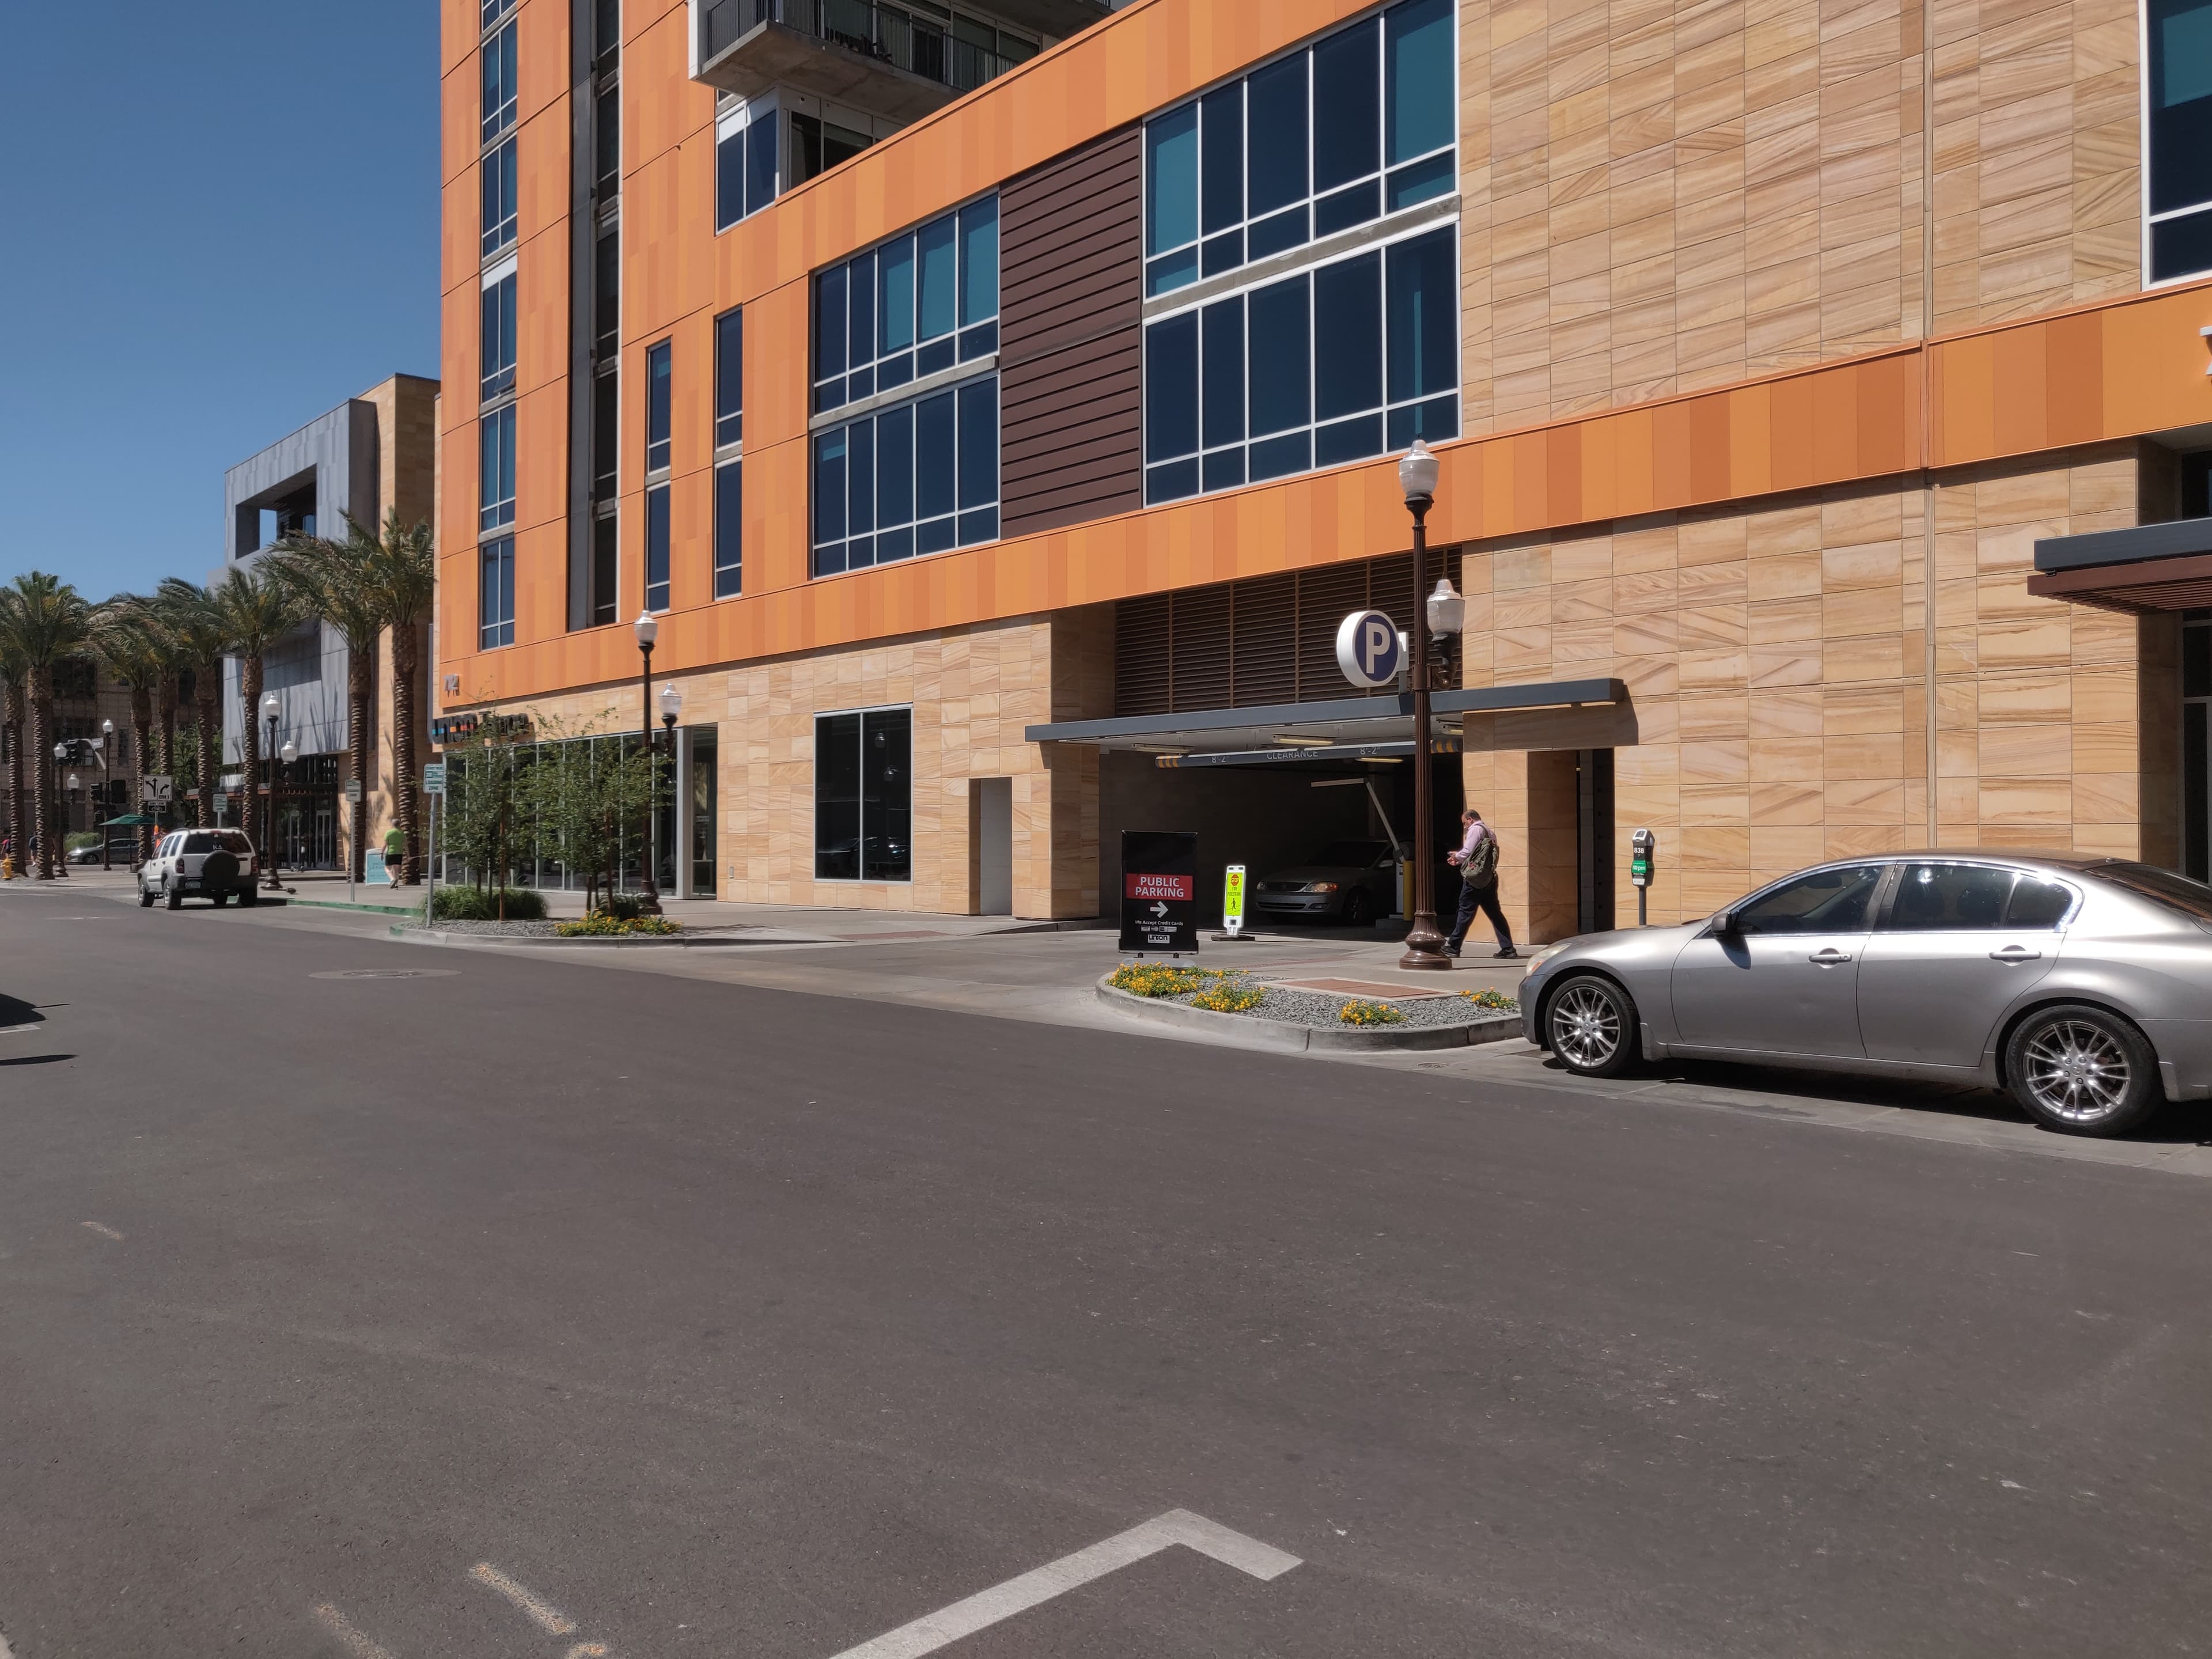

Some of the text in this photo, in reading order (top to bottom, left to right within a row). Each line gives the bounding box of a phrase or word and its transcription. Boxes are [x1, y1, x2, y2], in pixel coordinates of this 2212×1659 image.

[1366, 622, 1391, 674] P
[1267, 750, 1319, 760] CLEARANCE
[1141, 876, 1179, 887] PUBLIC
[1135, 887, 1184, 897] PARKING
